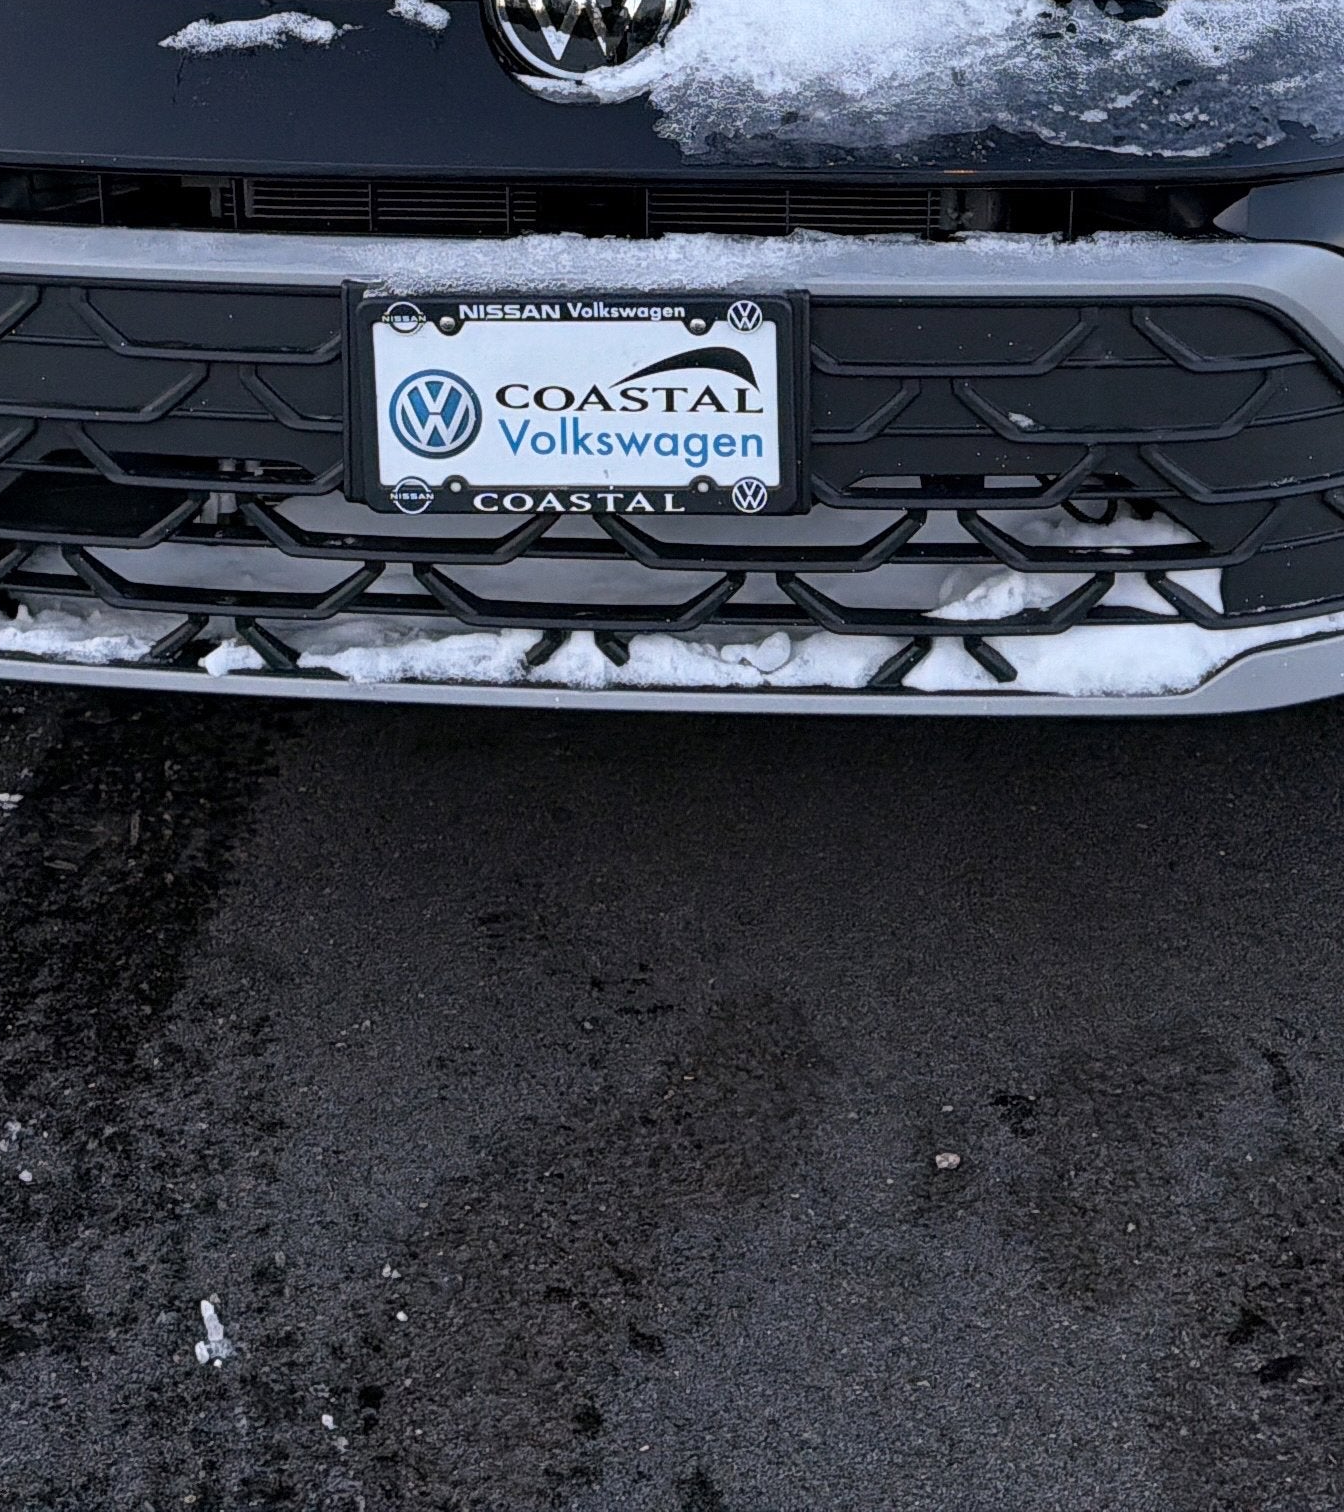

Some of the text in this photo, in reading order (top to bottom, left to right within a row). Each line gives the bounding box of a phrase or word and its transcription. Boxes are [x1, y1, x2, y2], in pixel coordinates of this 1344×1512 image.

[382, 315, 426, 323] NISSAN
[459, 302, 685, 321] NISSAN Volkswagen
[495, 384, 764, 414] COASTAL
[498, 416, 763, 468] Volkswagen
[389, 492, 434, 500] NISSAN
[473, 491, 685, 513] COASTAL
